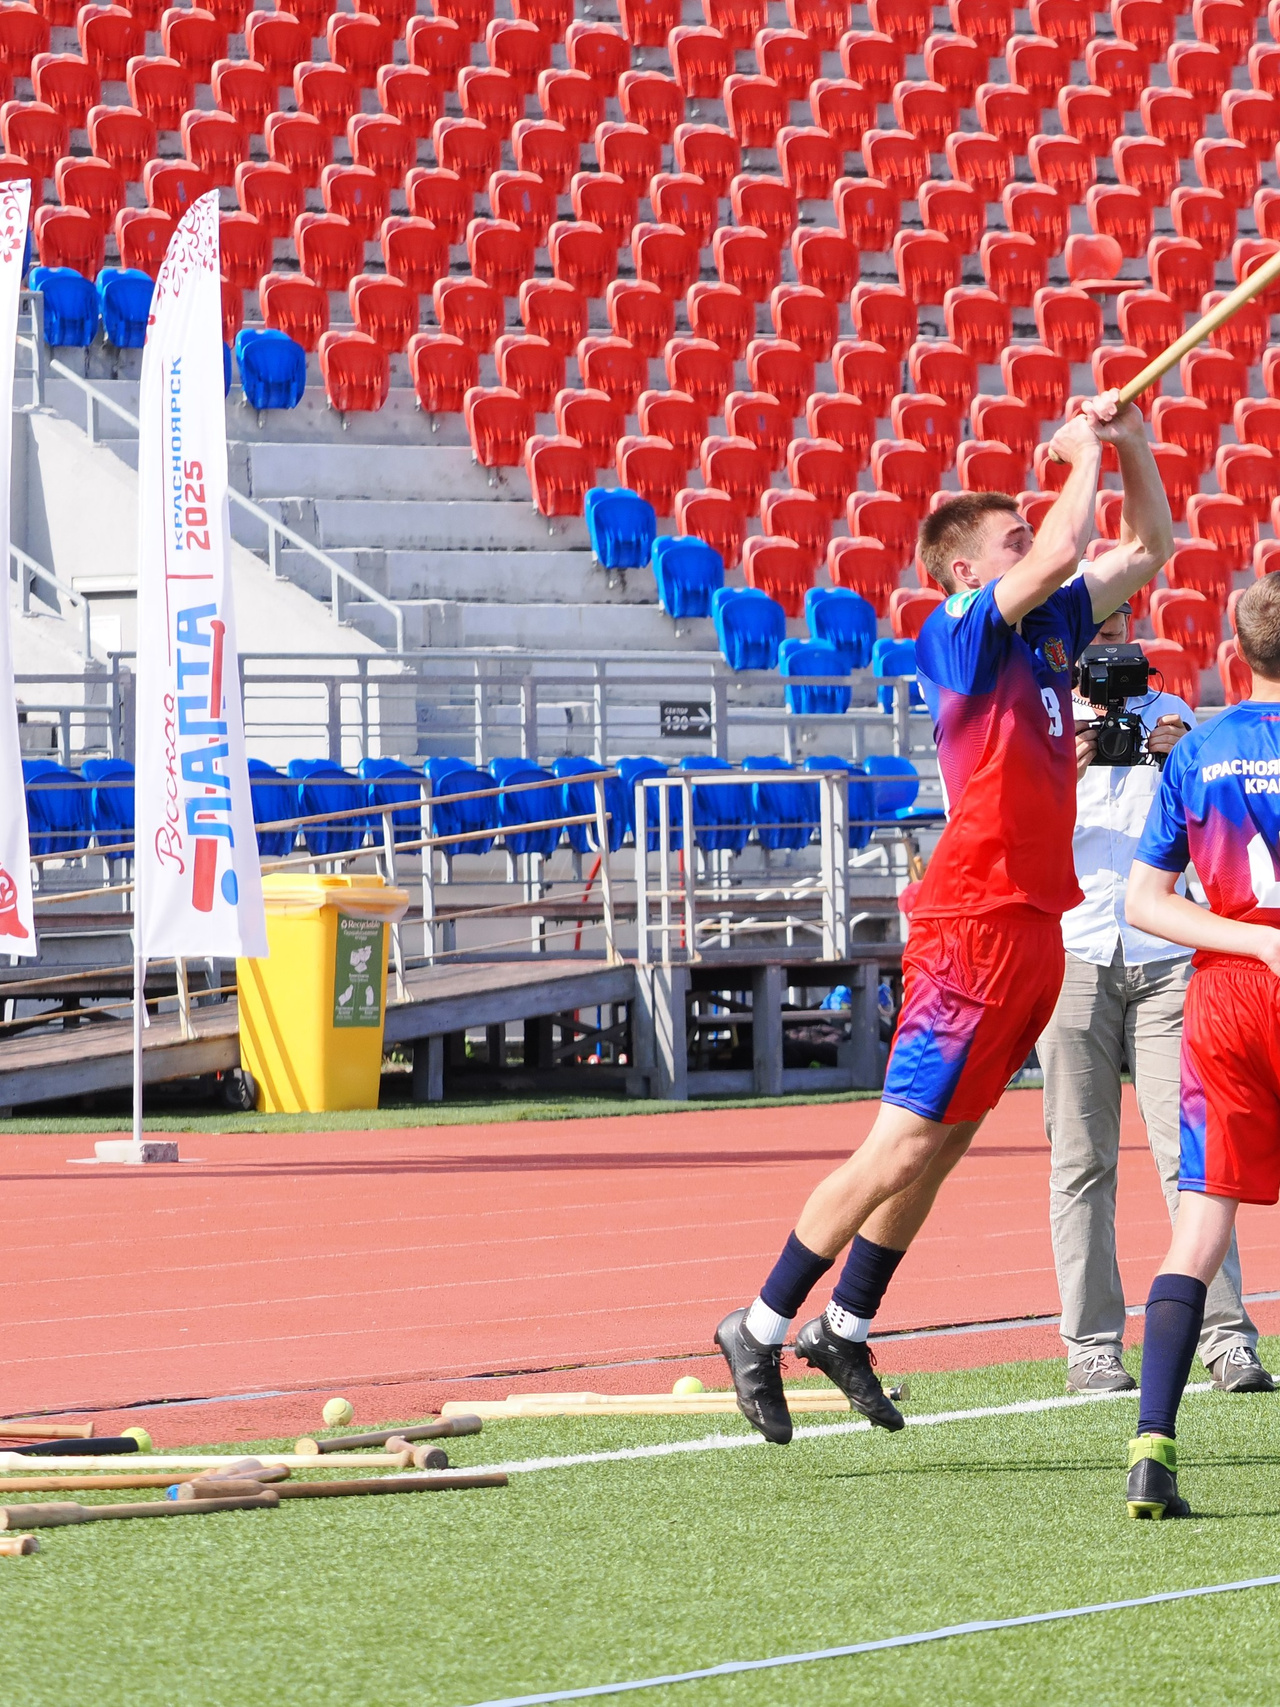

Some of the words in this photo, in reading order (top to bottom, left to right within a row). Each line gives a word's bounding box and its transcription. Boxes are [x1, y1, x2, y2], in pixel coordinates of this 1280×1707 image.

[169, 356, 184, 550] КРАСНОЯРСК
[184, 460, 211, 551] 2025
[176, 602, 236, 848] ЛАПТА
